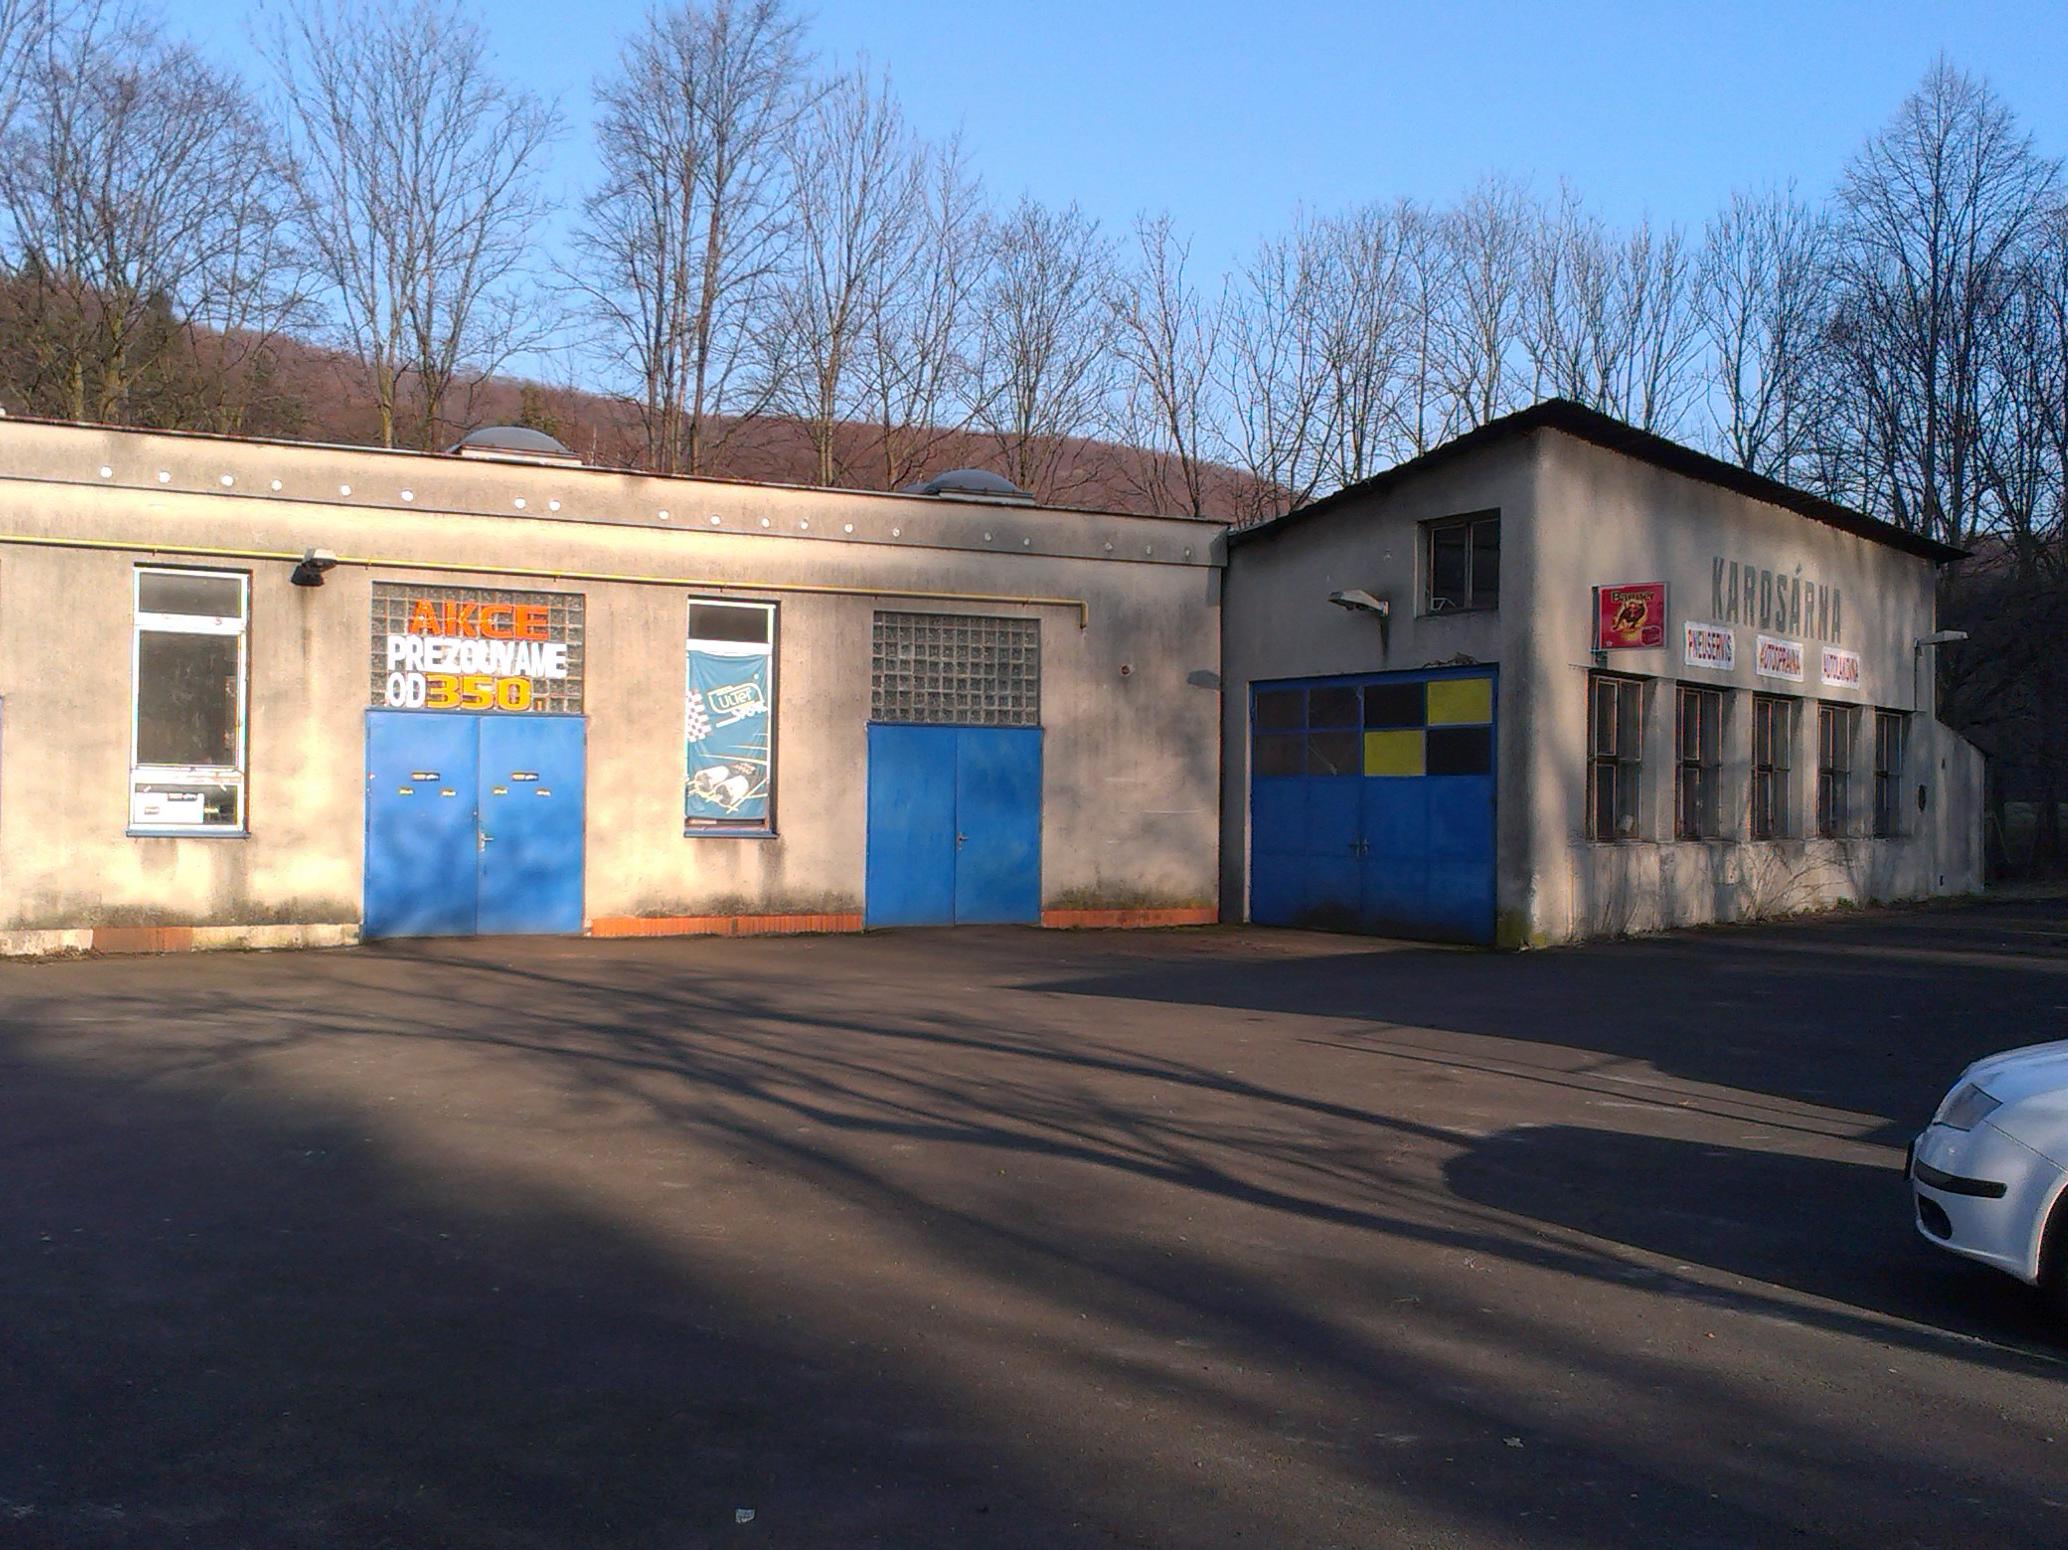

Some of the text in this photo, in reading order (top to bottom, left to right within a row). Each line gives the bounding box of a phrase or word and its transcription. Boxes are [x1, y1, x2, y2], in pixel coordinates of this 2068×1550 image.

[408, 599, 548, 640] AKCE
[1711, 555, 1841, 644] KAROSÁRNA
[387, 671, 426, 708] OD
